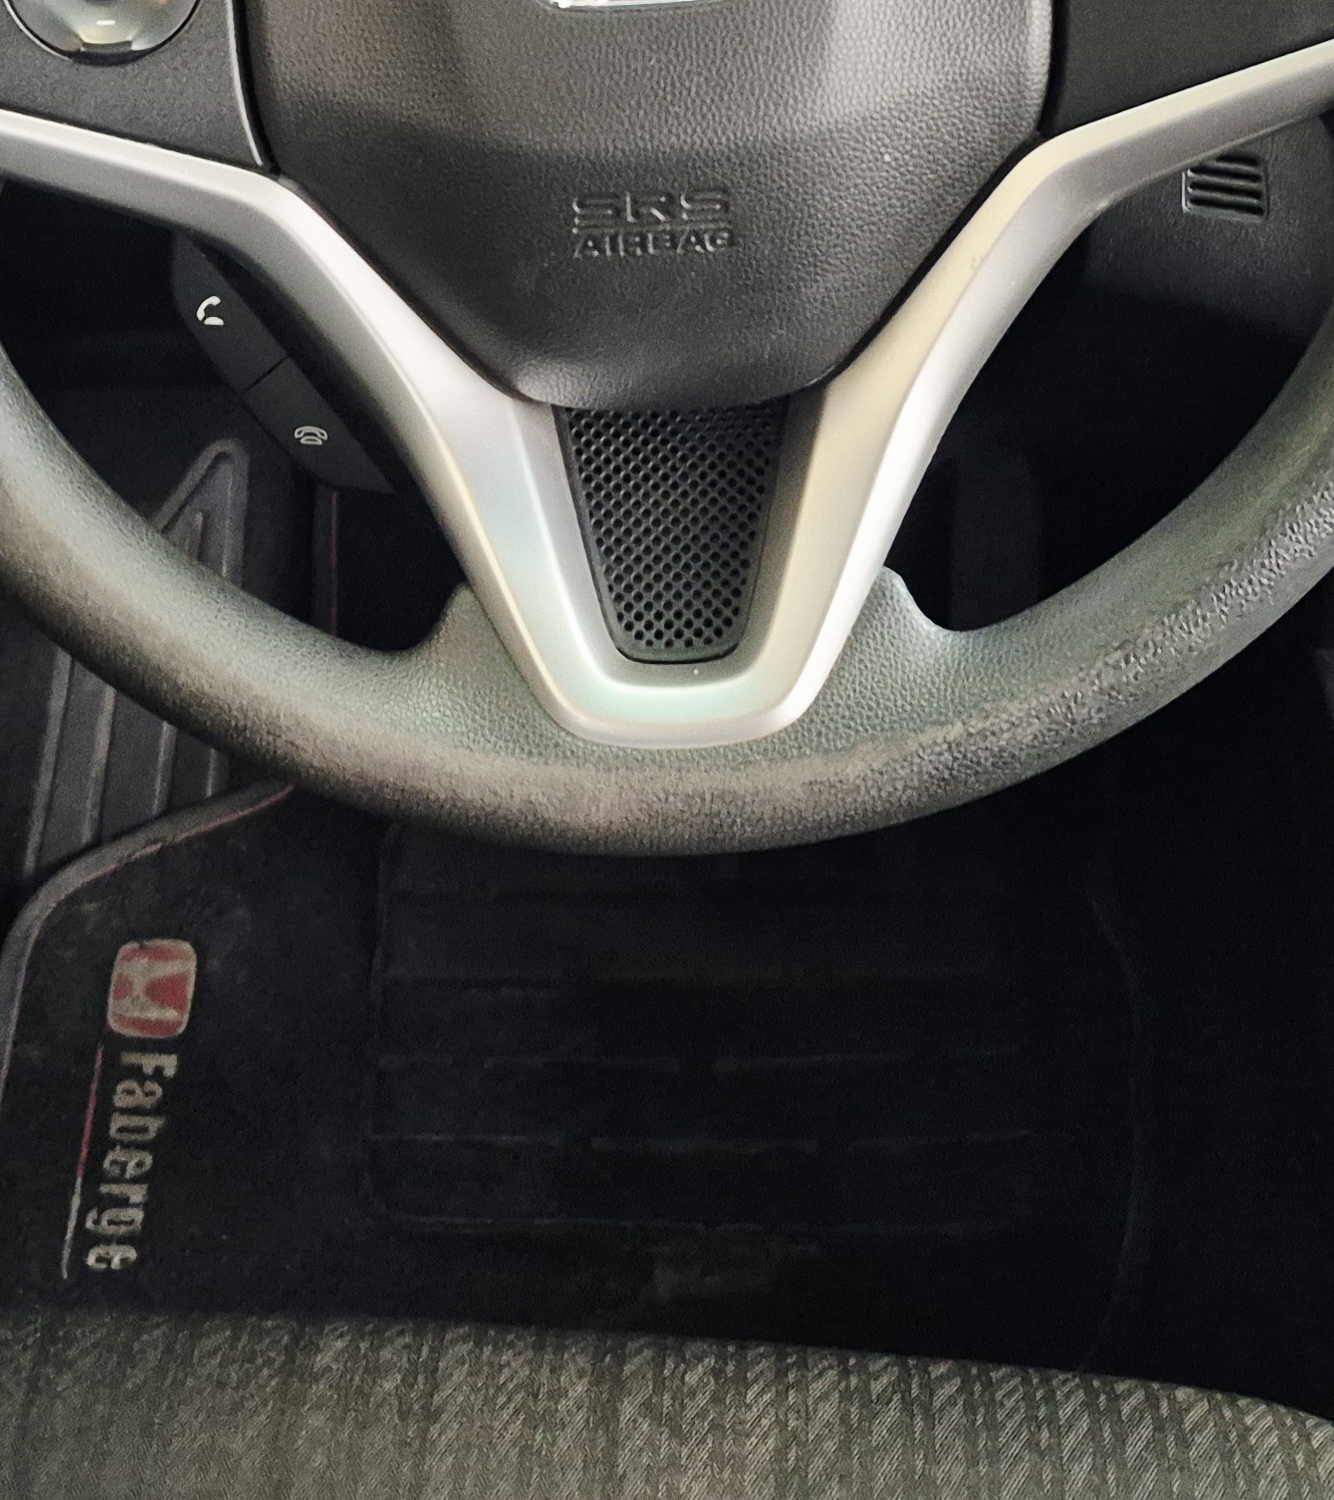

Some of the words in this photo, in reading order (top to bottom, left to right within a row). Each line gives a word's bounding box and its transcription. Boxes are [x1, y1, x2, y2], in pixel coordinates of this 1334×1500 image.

[570, 191, 730, 229] SRS
[571, 229, 737, 259] AIRBAG
[85, 1051, 179, 1272] Faberge
